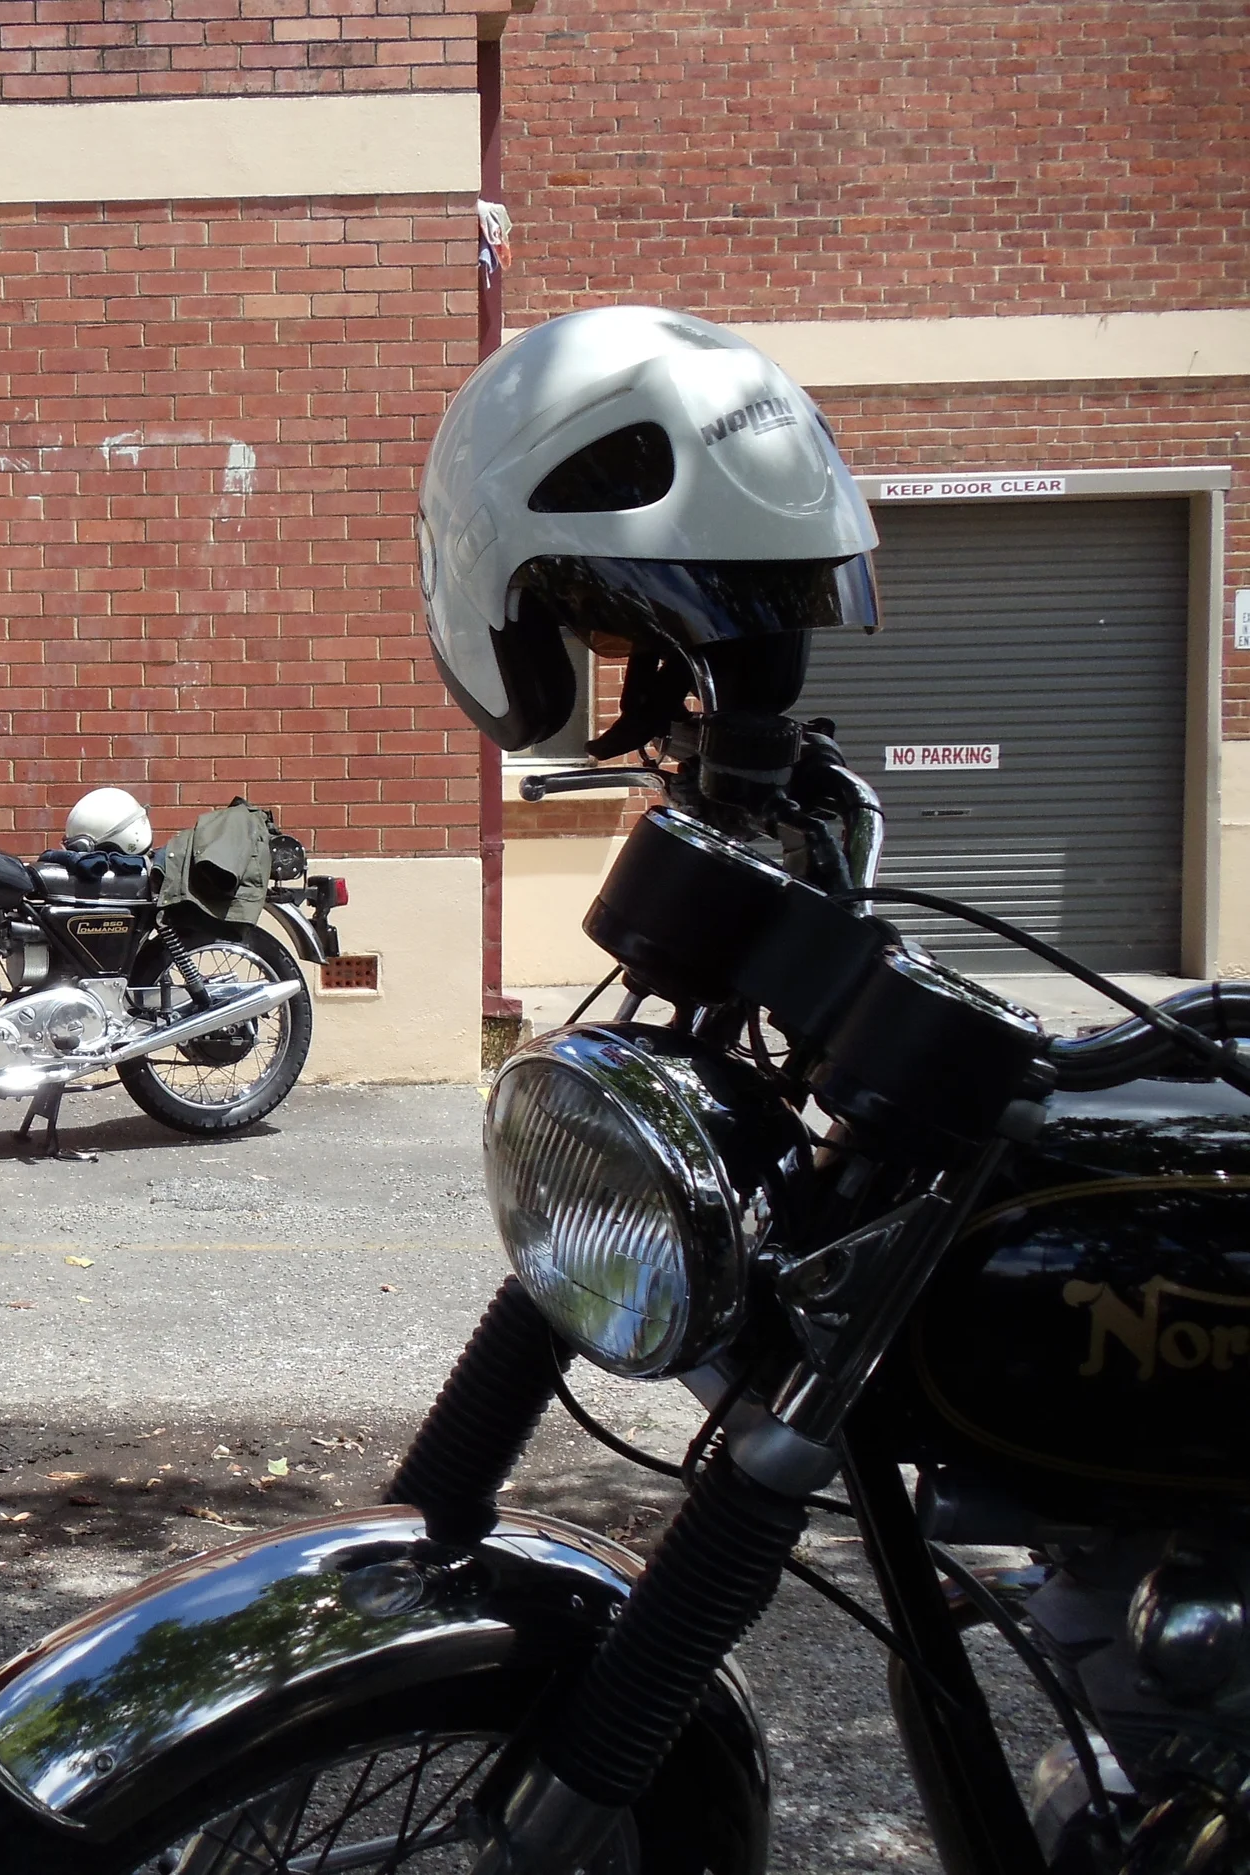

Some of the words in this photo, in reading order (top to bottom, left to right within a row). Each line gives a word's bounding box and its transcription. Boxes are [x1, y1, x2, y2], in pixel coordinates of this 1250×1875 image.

[701, 397, 797, 446] NOLAN
[886, 484, 934, 496] KEEP
[941, 482, 992, 495] DOOR
[1000, 480, 1062, 492] CLEAR
[893, 747, 915, 765] NO
[921, 746, 992, 764] PARKING
